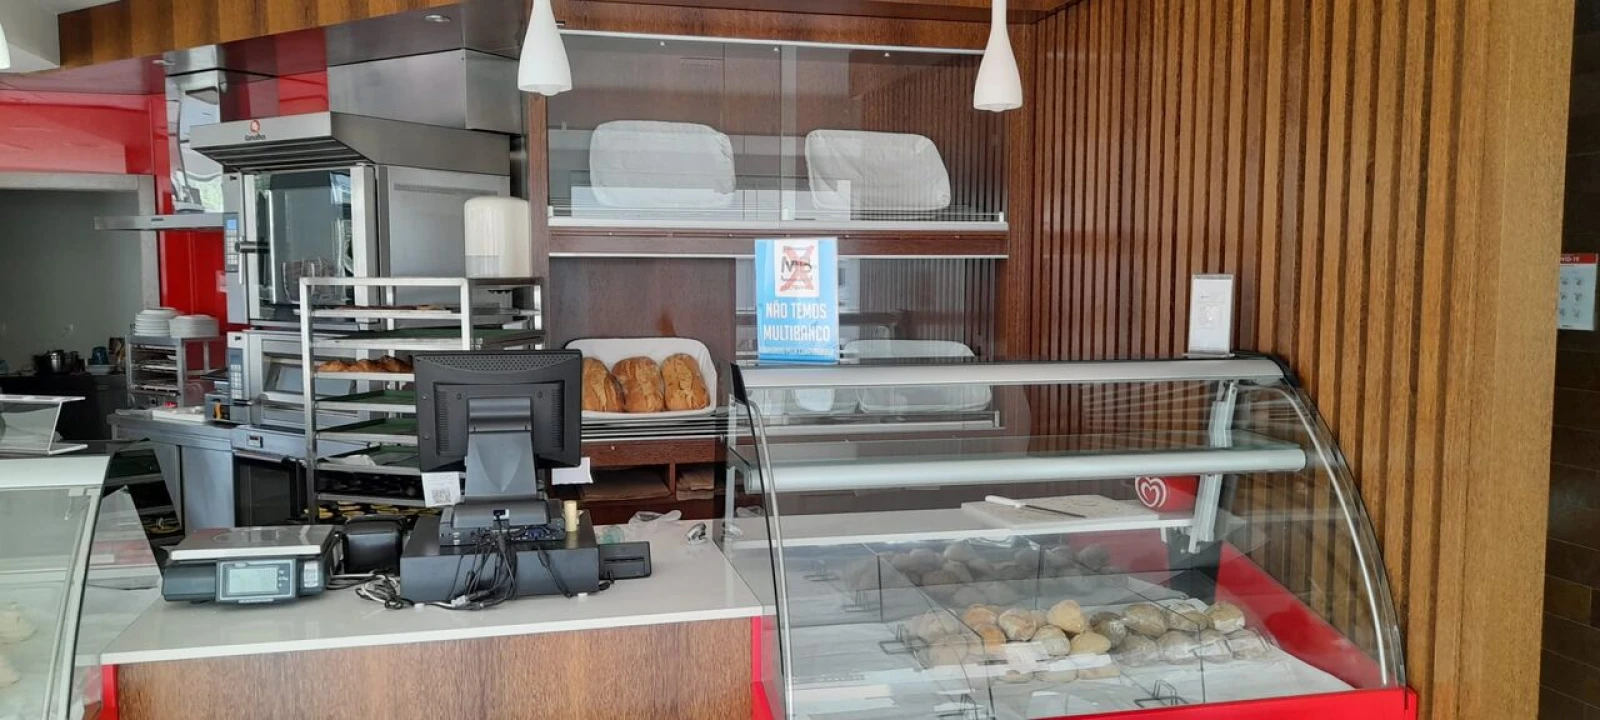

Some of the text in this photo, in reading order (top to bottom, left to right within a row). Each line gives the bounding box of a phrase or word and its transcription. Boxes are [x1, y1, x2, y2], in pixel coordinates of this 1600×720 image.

[765, 300, 828, 320] NÃO TEMOS
[763, 325, 831, 341] MULTIBANCO
